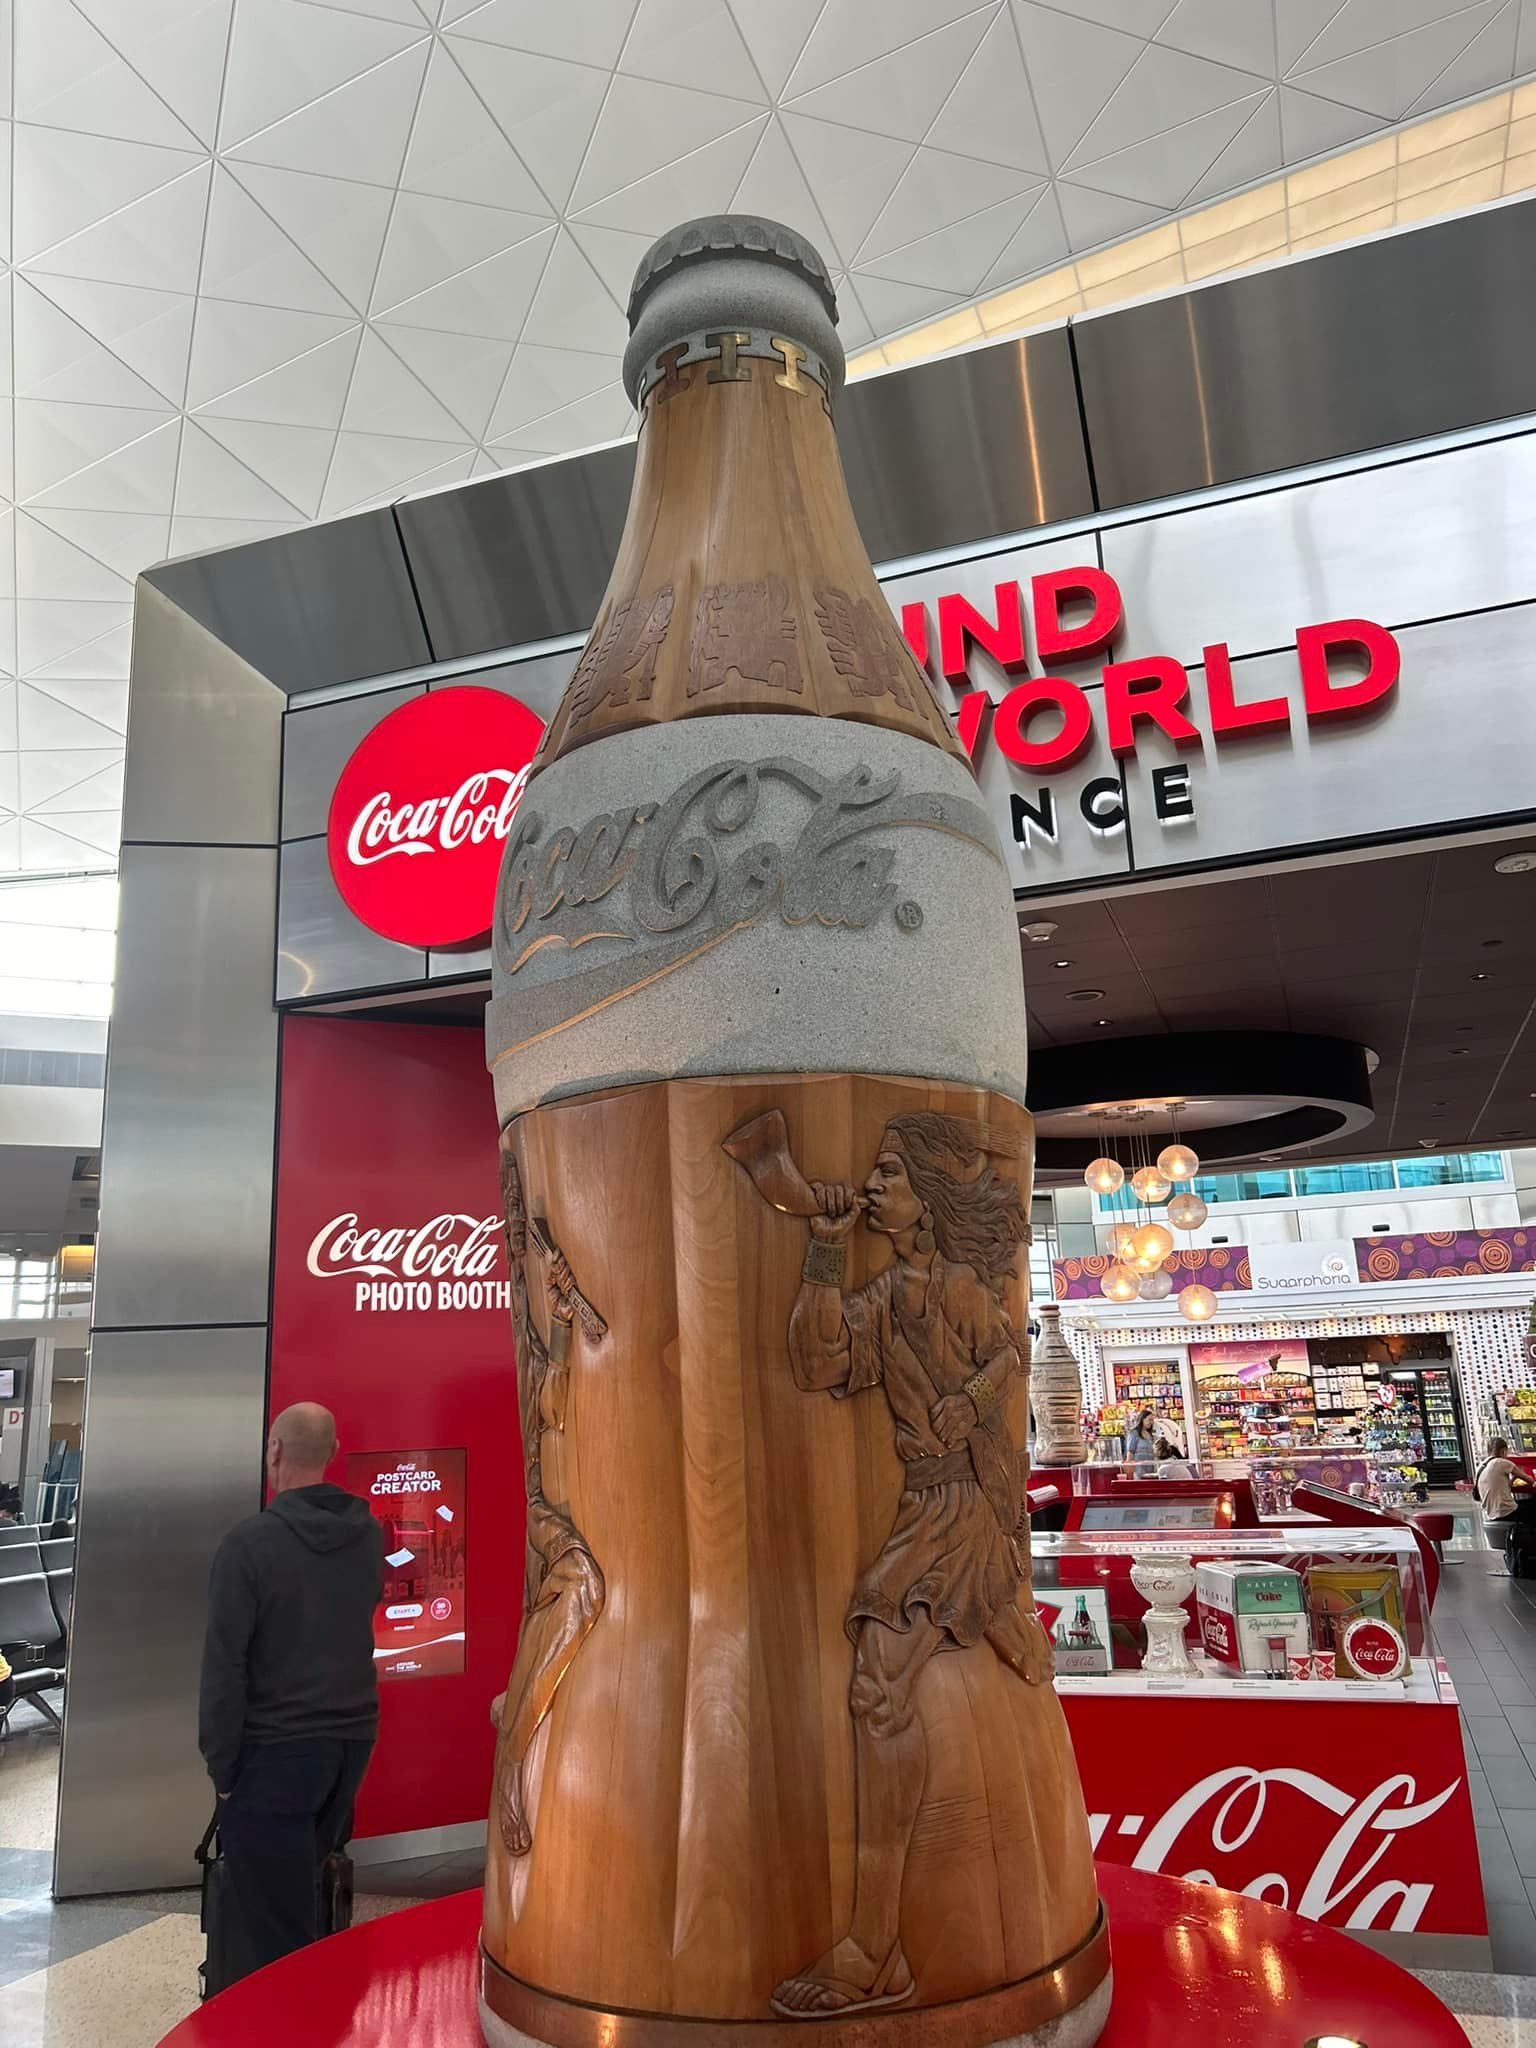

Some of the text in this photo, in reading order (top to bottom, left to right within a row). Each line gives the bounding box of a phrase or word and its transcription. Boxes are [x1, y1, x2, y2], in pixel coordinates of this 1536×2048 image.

[347, 762, 533, 866] Coca-Col
[306, 1212, 506, 1278] Coca-Cola
[355, 1280, 511, 1312] PHOTO BOOTH
[370, 1480, 442, 1495] CREATOR
[376, 1471, 436, 1482] POSTCARD
[1255, 1592, 1283, 1602] Coke
